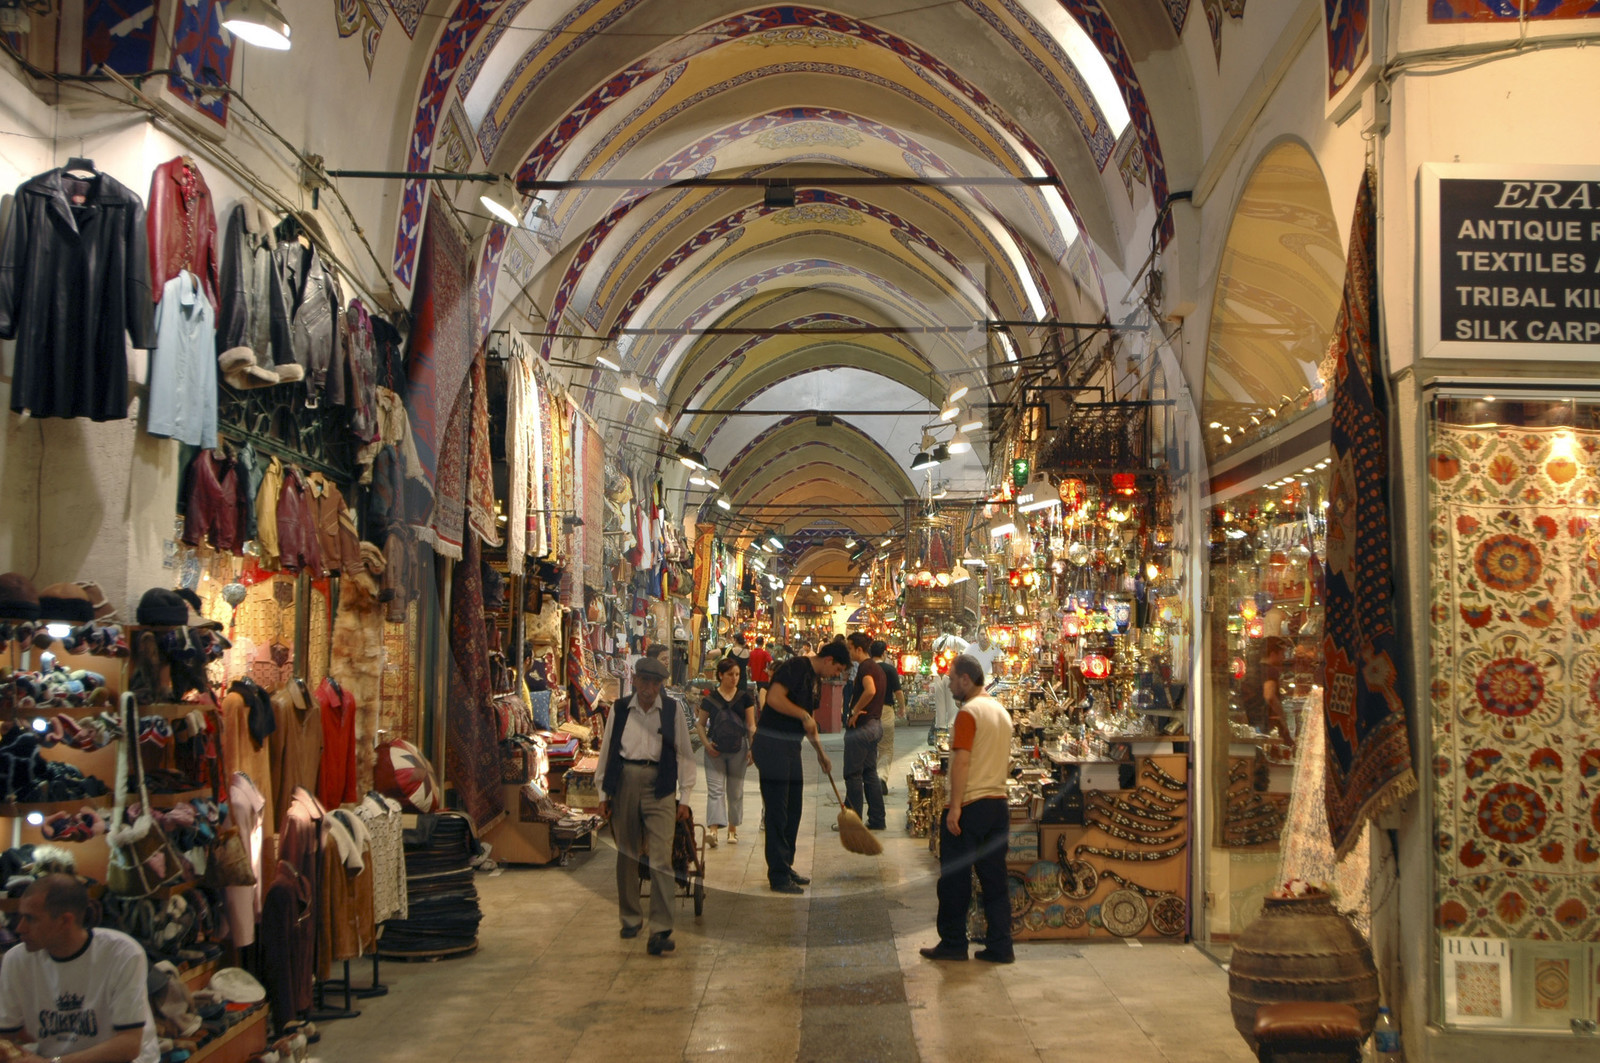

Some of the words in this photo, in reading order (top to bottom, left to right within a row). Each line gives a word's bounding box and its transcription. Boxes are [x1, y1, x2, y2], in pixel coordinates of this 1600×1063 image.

[1494, 181, 1600, 210] ERA
[1457, 219, 1582, 242] ANTIQUE
[1456, 250, 1586, 274] TEXTILES
[1456, 285, 1556, 308] TRIBAL
[1455, 319, 1519, 340] SILK
